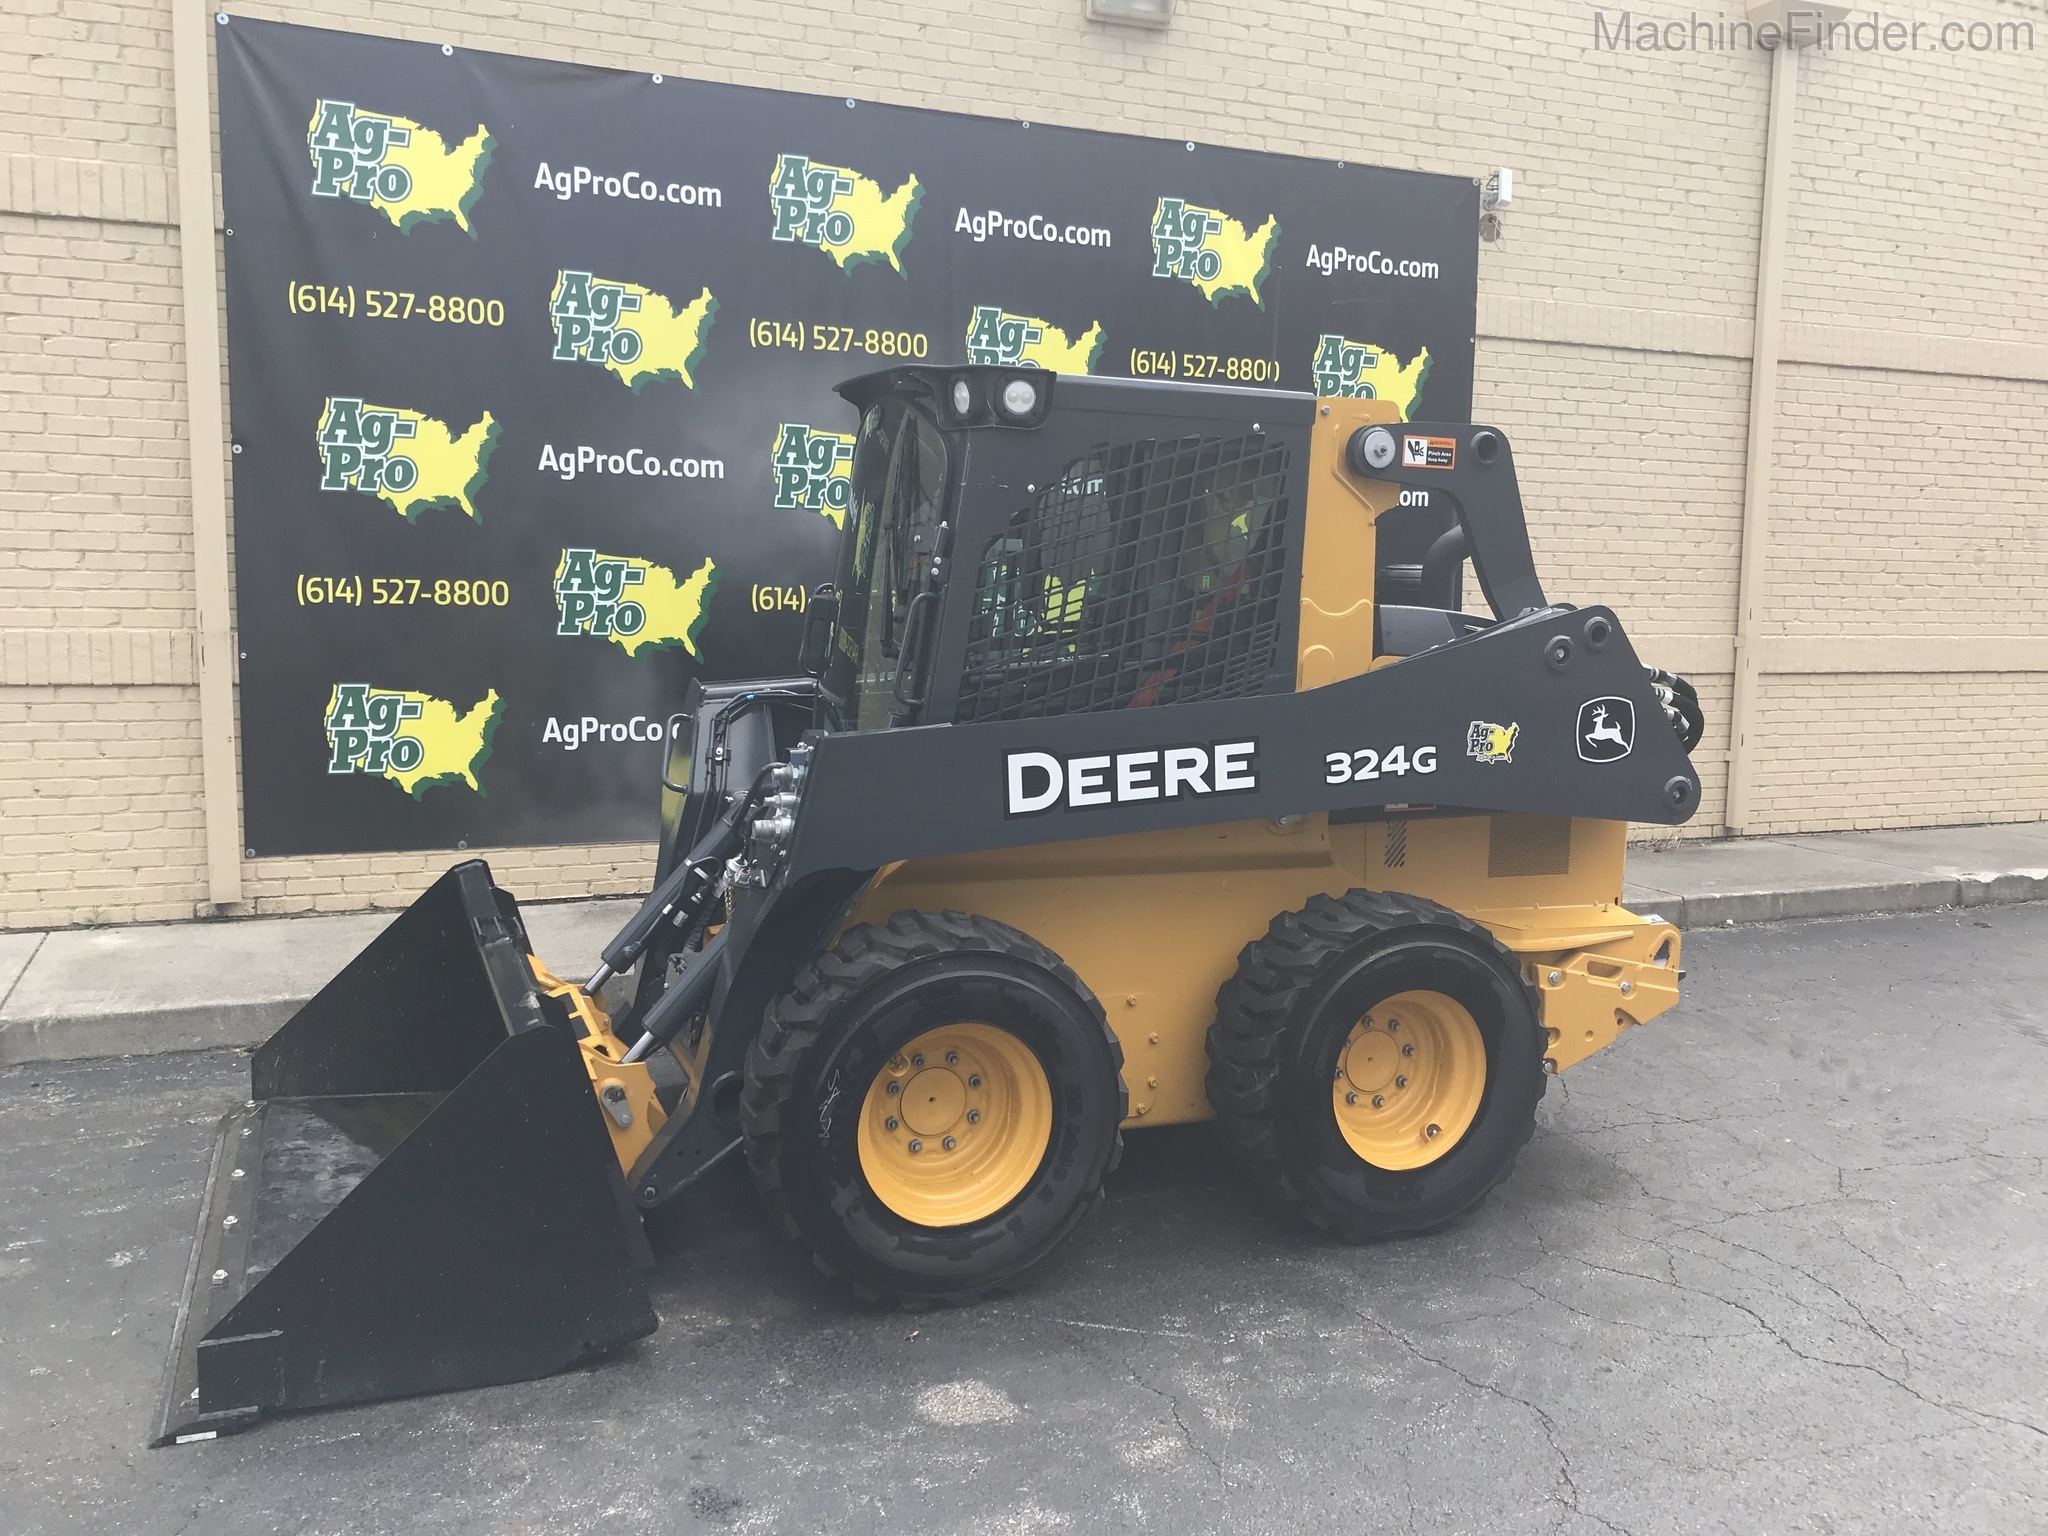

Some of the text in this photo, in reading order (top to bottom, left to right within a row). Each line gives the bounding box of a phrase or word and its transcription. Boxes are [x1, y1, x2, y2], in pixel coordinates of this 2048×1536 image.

[311, 100, 409, 162] Ag-
[312, 148, 411, 201] Pro
[533, 161, 722, 207] AgProCo.com
[772, 154, 854, 210] Ag-
[772, 198, 853, 245] Pro
[954, 206, 1111, 247] AgProCo.com
[1153, 198, 1222, 249] Ag-
[1153, 238, 1221, 281] Pro
[1305, 243, 1439, 280] AgProCo.com
[288, 281, 505, 327] (614) 527-8800
[552, 271, 641, 328] Ag-
[553, 316, 642, 363] Pro
[749, 317, 928, 357] (614) 527-8800
[1130, 347, 1280, 383] (614) 527-8800
[320, 398, 416, 456] Ag-
[321, 444, 417, 492] Pro
[537, 444, 725, 480] AgProCo.com
[775, 466, 851, 509] Pro
[297, 574, 509, 607] (614) 527-8800
[557, 549, 645, 602] Ag-
[751, 583, 806, 613] (614)
[558, 591, 646, 635] Pro
[328, 684, 422, 737] Ag-
[542, 716, 681, 751] AgProCo
[329, 727, 423, 773] Pro
[1325, 745, 1437, 785] 324G
[1470, 738, 1493, 753] Pro
[1007, 741, 1255, 814] DEERE
